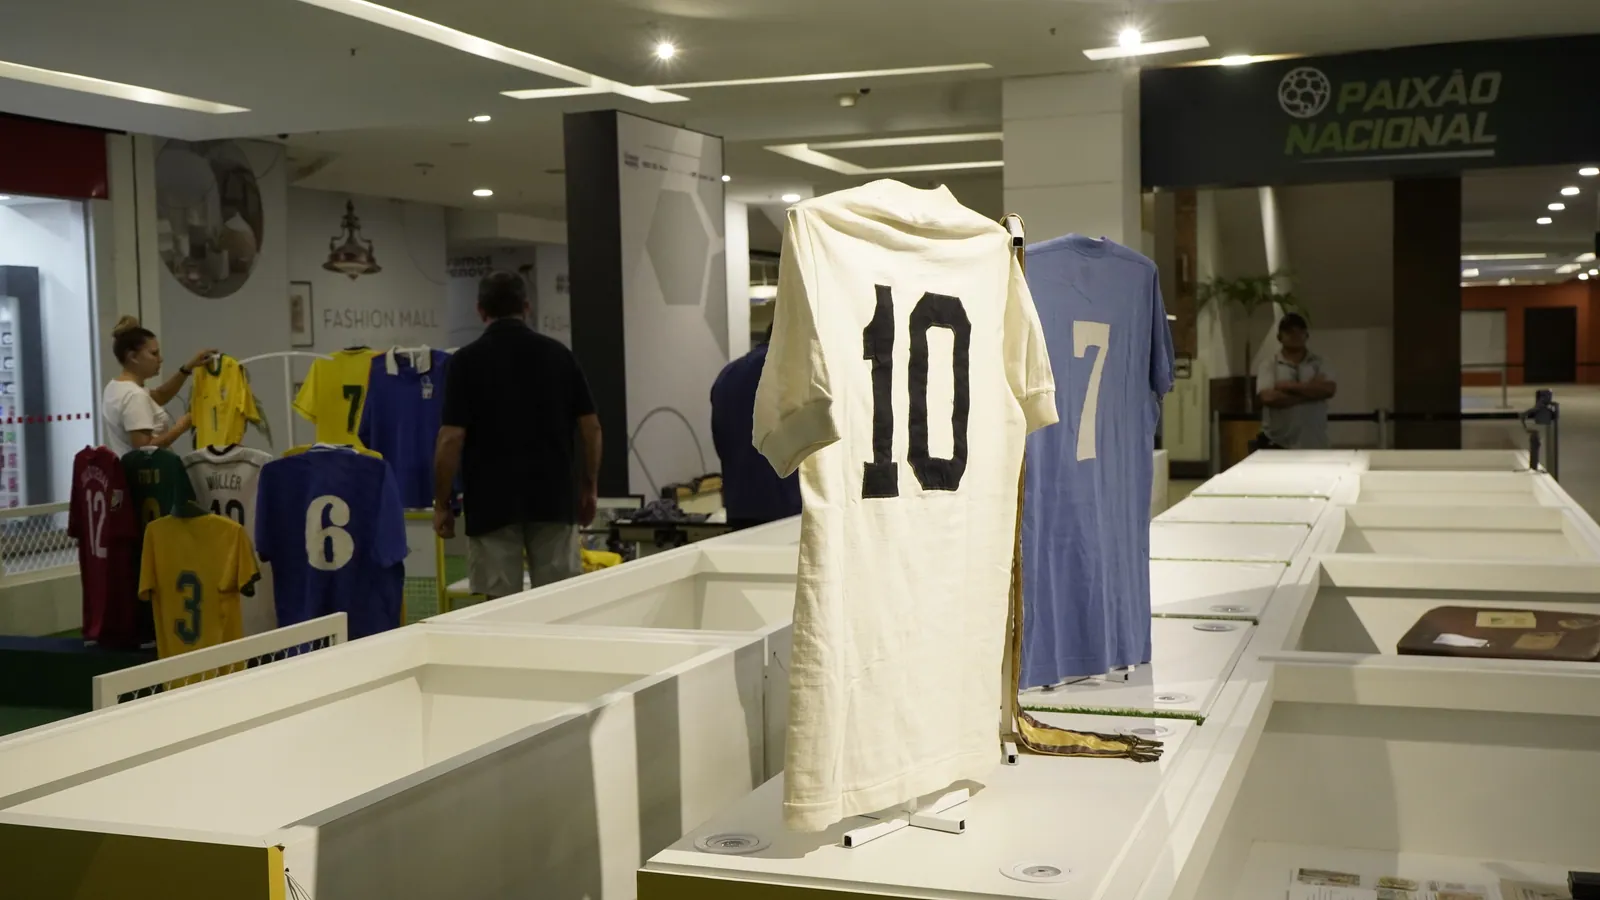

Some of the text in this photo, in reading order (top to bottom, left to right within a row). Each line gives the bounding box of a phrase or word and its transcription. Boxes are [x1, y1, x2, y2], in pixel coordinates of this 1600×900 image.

[1337, 68, 1502, 114] PAIXÃO
[1284, 112, 1497, 155] NACIONAL
[323, 308, 438, 329] FASHION MALL
[342, 385, 363, 433] 7
[862, 284, 971, 499] 10
[1073, 320, 1110, 461] 7
[206, 471, 243, 491] MÜLLER
[86, 488, 107, 558] 12
[305, 495, 354, 571] 6
[176, 571, 203, 644] 3
